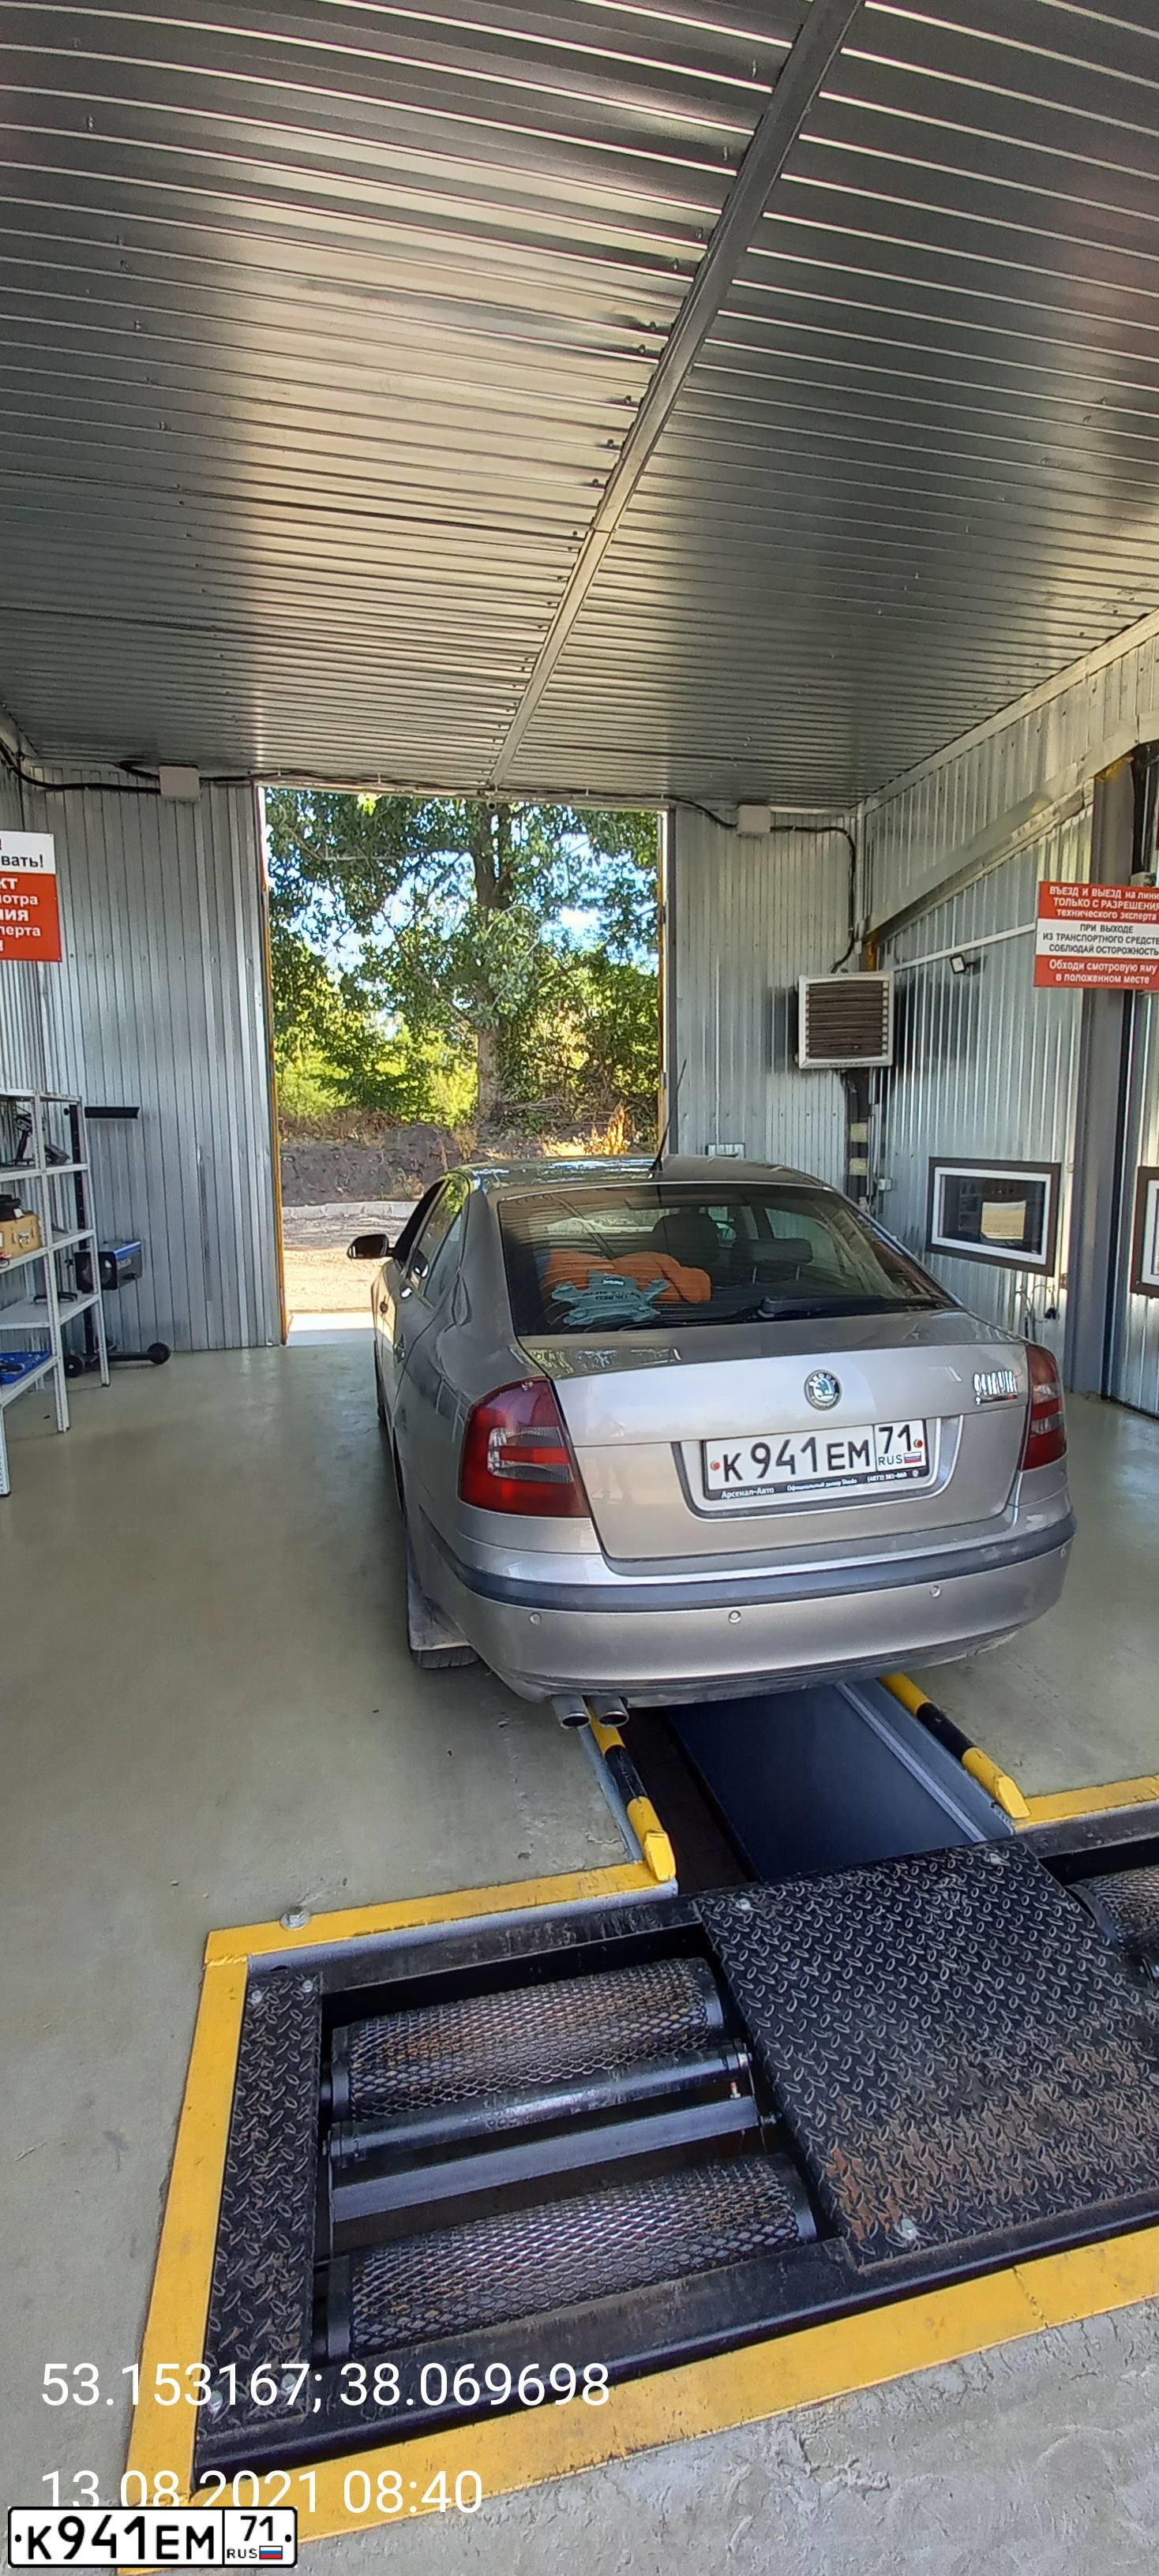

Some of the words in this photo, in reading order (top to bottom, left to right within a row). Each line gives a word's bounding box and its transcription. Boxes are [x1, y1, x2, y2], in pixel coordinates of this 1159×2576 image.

[1092, 889, 1122, 899] ВЫЕЗД
[1053, 897, 1090, 908] ТОЛЬКО
[1092, 900, 1099, 908] С
[1100, 925, 1134, 934] ВЫХОДЕ
[1056, 933, 1123, 944] ТРАНСПОРТНОГО
[1048, 944, 1094, 953] СОБЛЮДАЙ
[1048, 959, 1085, 972] Обходи
[1086, 962, 1138, 975] смотровую
[1139, 964, 1157, 975] яму
[1123, 975, 1150, 984] месте
[878, 1454, 902, 1466] RUS
[721, 1486, 775, 1500] Арсенал-Авто
